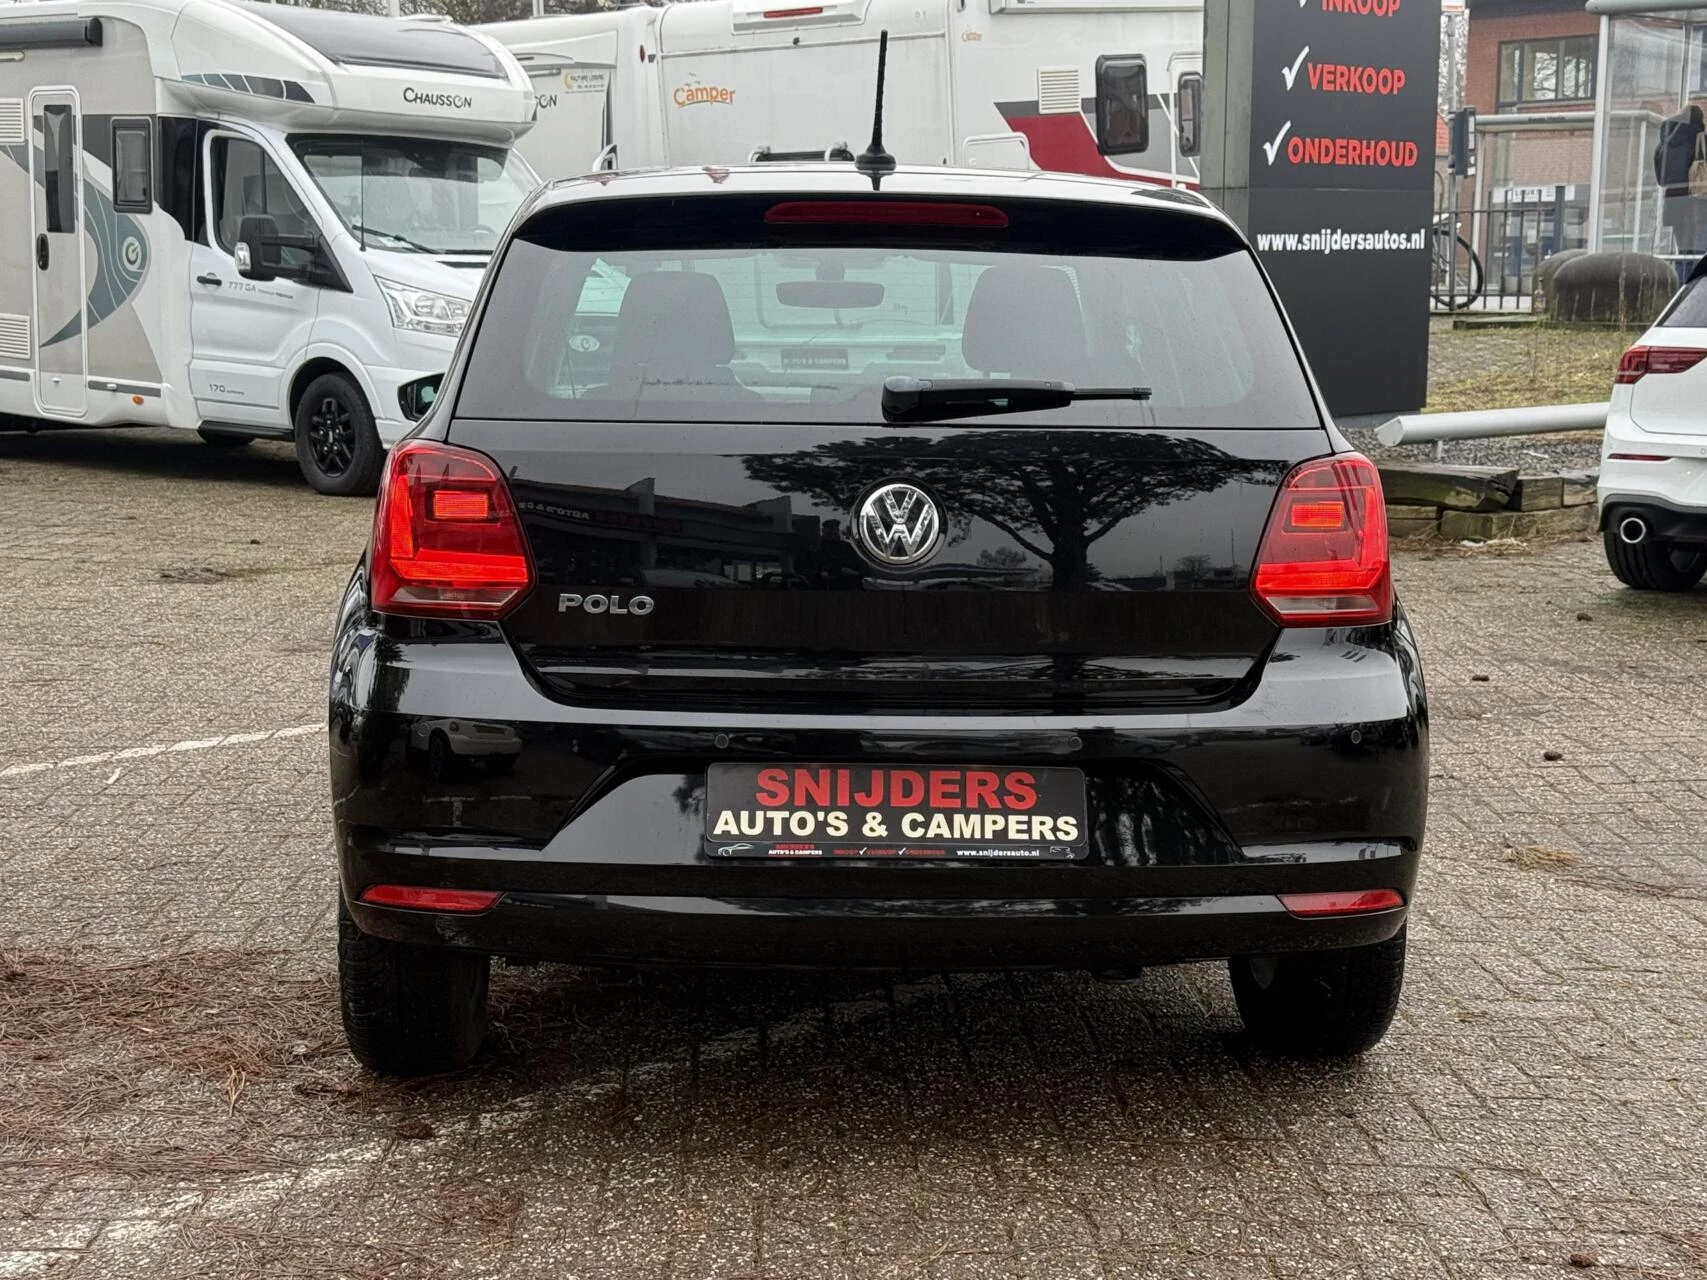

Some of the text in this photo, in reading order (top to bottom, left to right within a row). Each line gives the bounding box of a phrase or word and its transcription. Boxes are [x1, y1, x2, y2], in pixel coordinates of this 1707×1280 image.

[1307, 62, 1406, 95] VERKOOP
[535, 94, 557, 108] ON
[673, 85, 736, 107] Camper
[1287, 136, 1418, 167] ONDERHOUD
[1256, 228, 1426, 255] www.snijdersautos.nl
[228, 281, 257, 293] 777 GA
[209, 384, 226, 393] 170
[558, 593, 655, 616] POLO
[755, 767, 1038, 811] SNIJDERS
[713, 810, 1079, 842] AUTO'S & CAMPERS
[956, 849, 1040, 858] www.snijdersauto.nl
